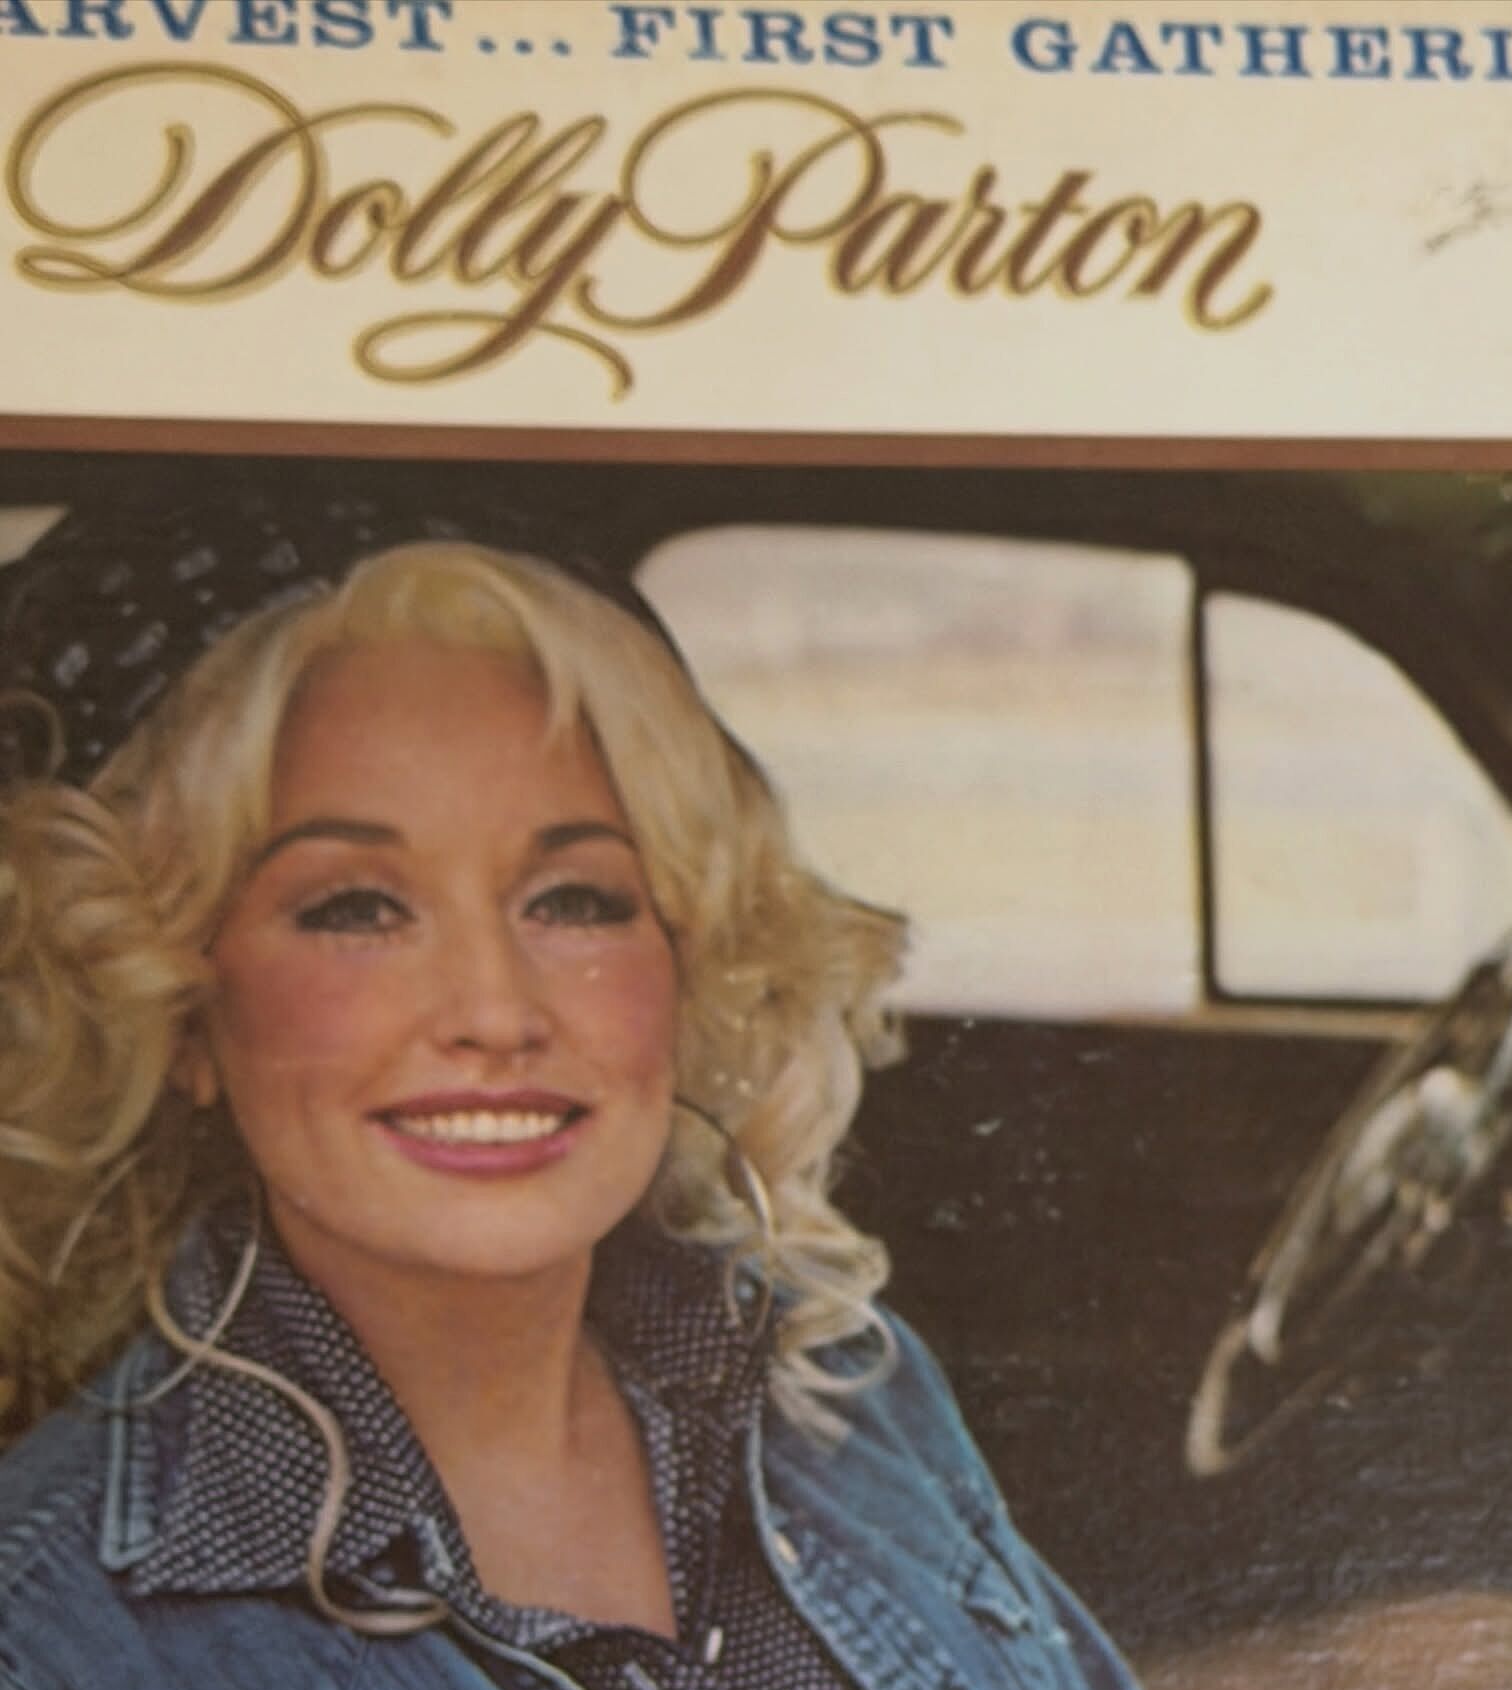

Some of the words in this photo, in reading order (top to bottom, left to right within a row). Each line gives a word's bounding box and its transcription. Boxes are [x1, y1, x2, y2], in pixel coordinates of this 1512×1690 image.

[610, 8, 954, 69] FIRST
[5, 60, 636, 403] Dolly
[572, 86, 1275, 333] Parton
